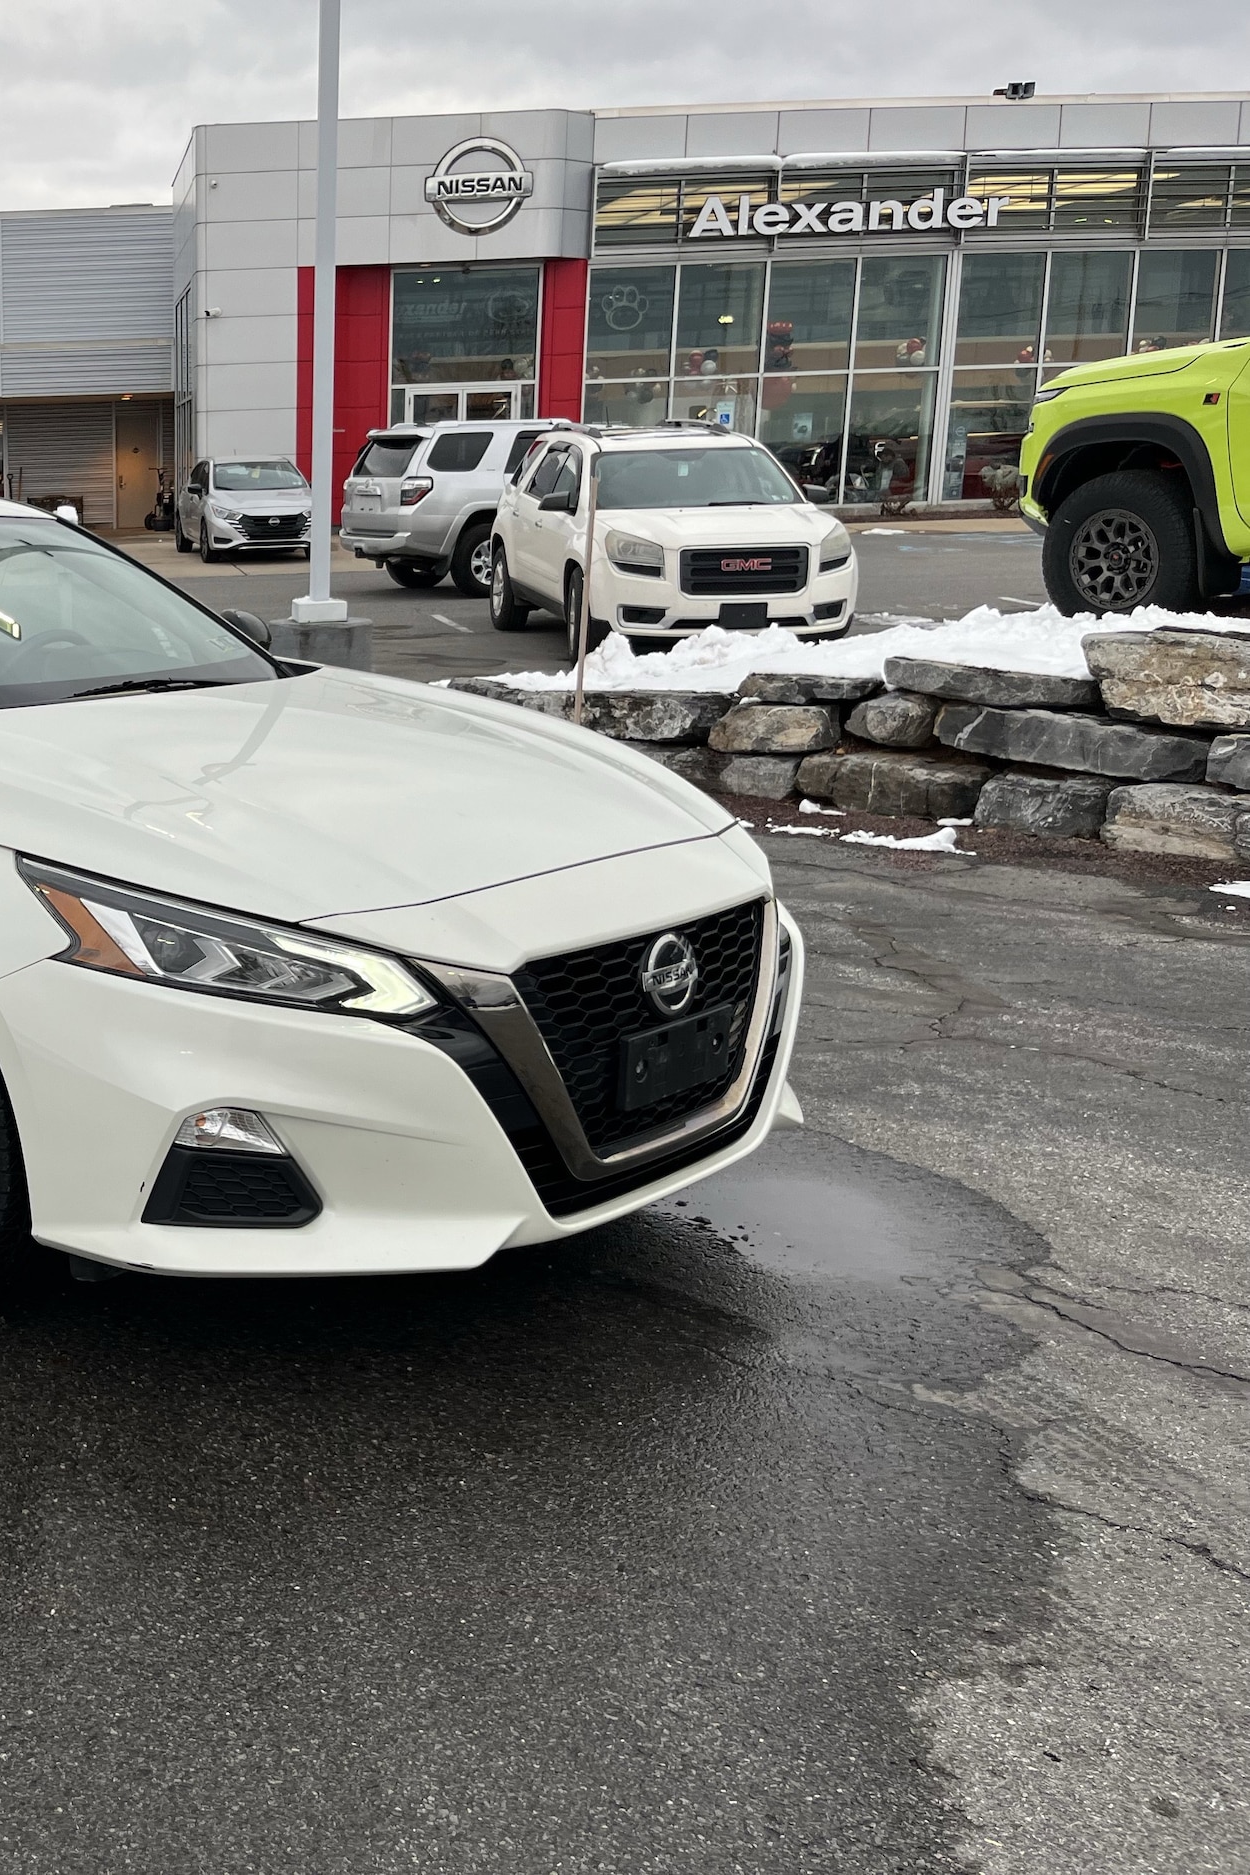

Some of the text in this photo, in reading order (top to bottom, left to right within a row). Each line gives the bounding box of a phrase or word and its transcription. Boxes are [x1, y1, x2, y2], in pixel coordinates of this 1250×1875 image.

[437, 176, 524, 197] NISSAN
[688, 188, 1010, 238] Alexander
[721, 558, 772, 571] GMC
[652, 967, 693, 986] NISSAN
